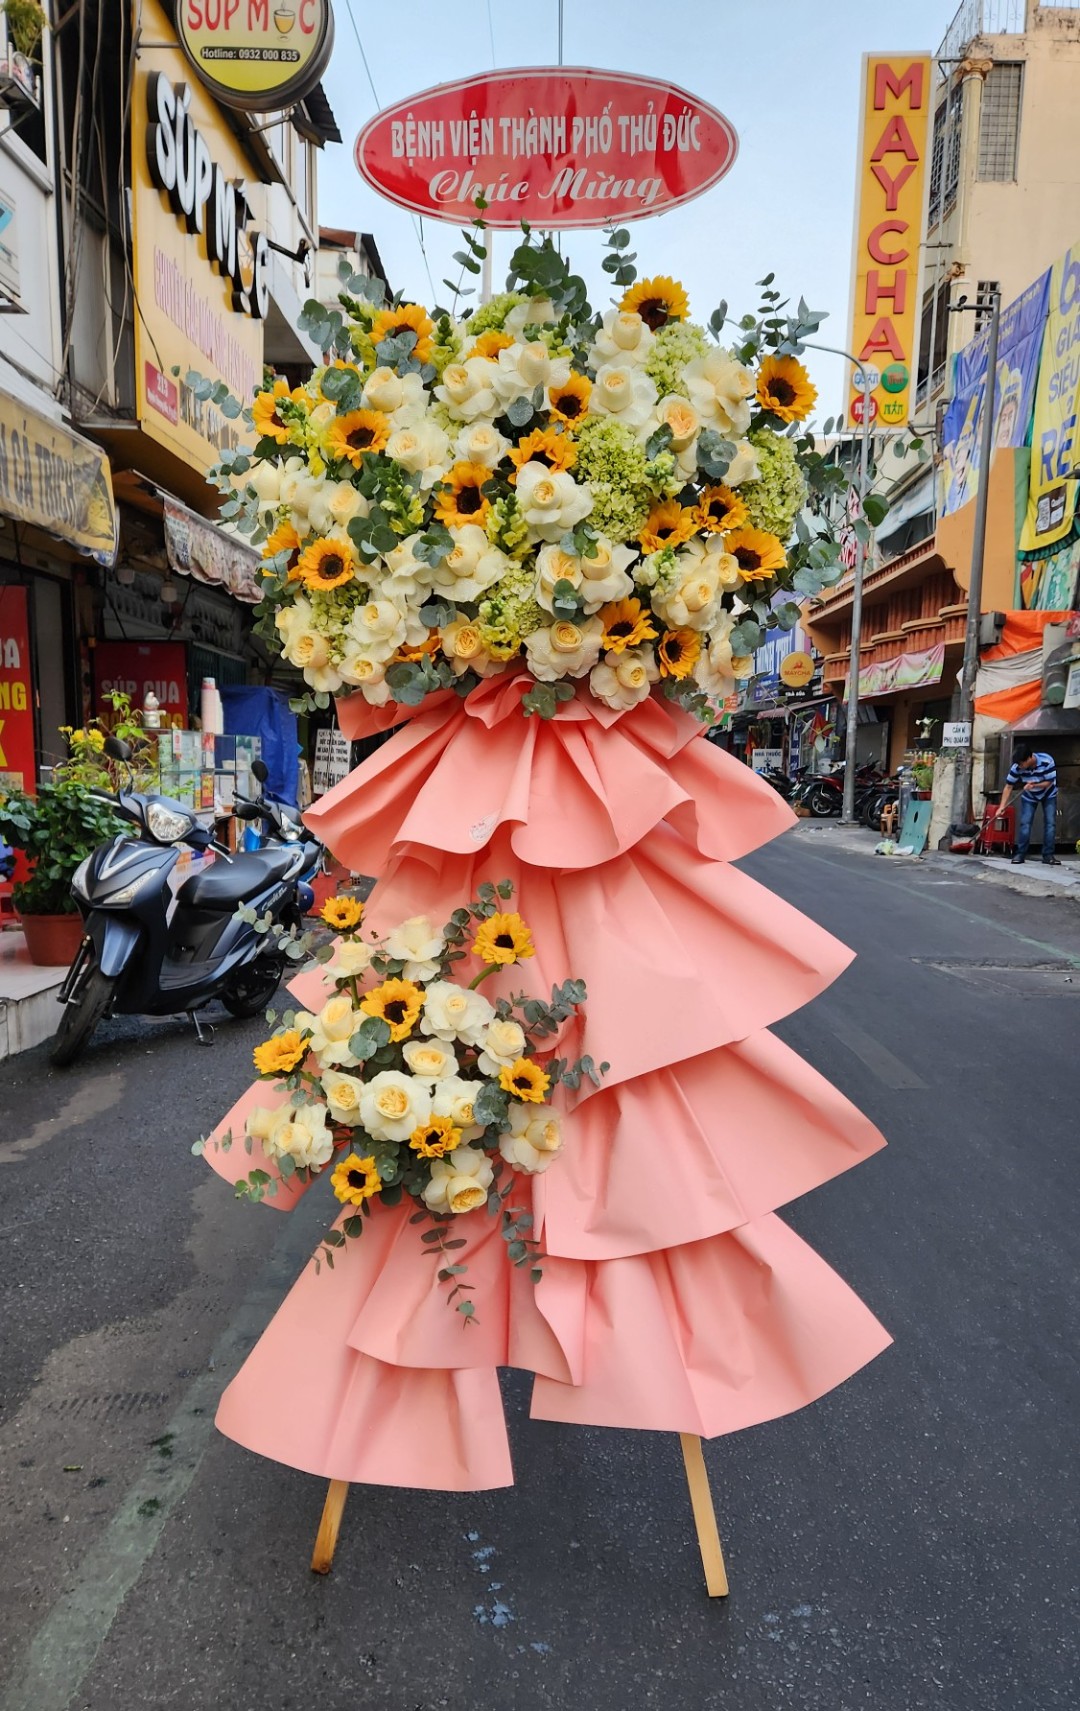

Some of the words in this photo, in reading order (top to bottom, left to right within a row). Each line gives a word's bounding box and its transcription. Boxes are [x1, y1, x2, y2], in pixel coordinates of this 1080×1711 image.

[202, 48, 236, 59] Hotline:
[238, 49, 260, 59] 0932
[262, 50, 279, 60] 000
[281, 51, 298, 61] 835
[391, 112, 445, 167] BỆNH
[449, 110, 494, 166] VIỆN
[499, 108, 567, 160] THÀNH
[572, 101, 613, 158] PHỐ
[617, 101, 657, 157] THỦ
[663, 106, 700, 151] ĐỨC
[428, 169, 530, 203] Chúc
[538, 167, 665, 205] Mừng
[858, 63, 924, 361] MAYCHA
[11, 419, 35, 510] CÁ
